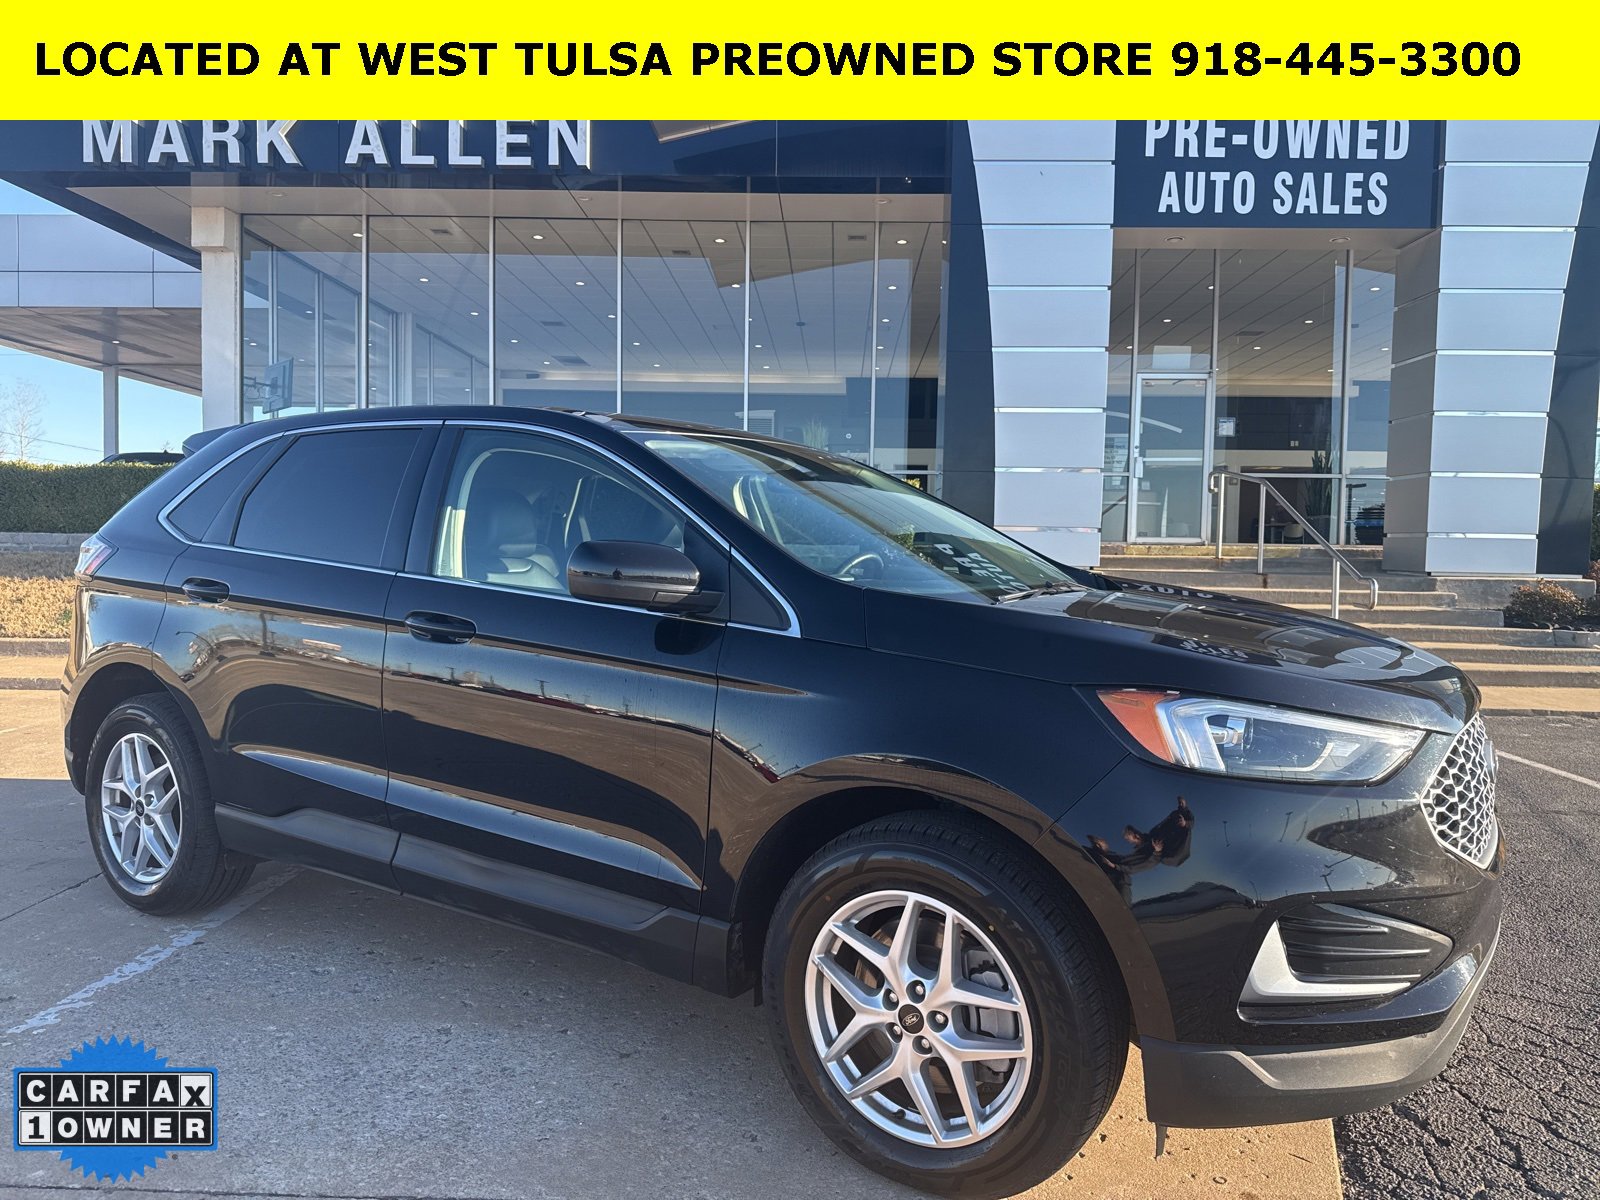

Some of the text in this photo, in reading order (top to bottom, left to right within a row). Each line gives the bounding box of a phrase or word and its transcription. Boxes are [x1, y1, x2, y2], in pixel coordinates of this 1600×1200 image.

[82, 120, 591, 169] MARK ALLEN
[1145, 120, 1410, 160] PRE-OWNED
[1158, 171, 1389, 216] AUTO SALES
